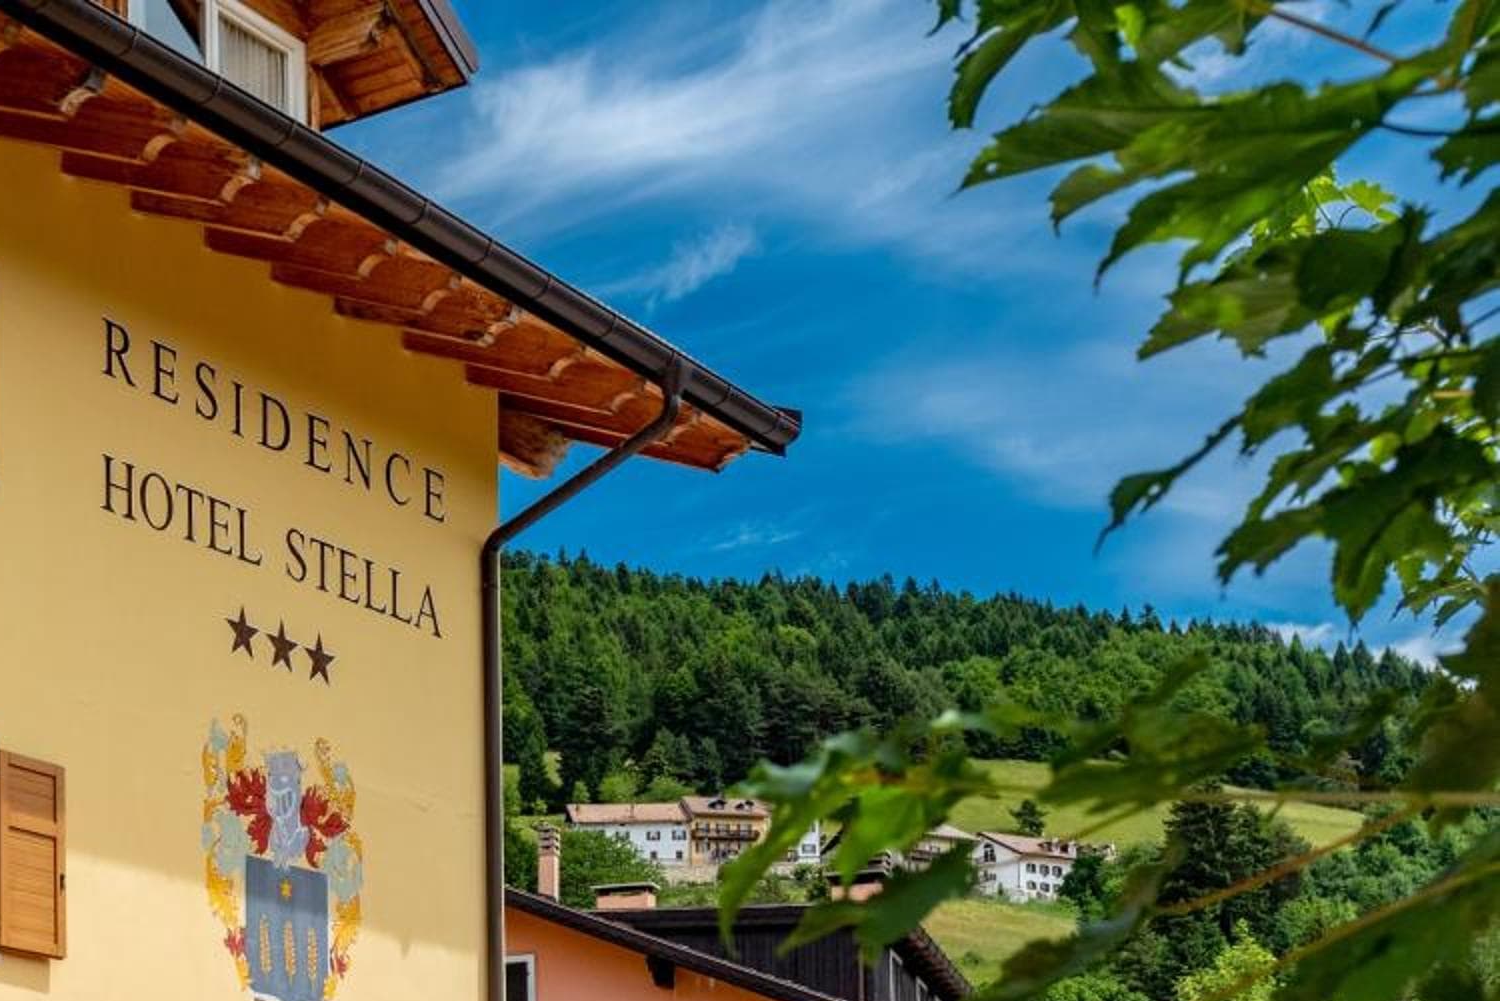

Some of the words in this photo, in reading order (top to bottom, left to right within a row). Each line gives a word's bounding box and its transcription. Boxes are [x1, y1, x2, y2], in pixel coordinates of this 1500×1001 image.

[102, 317, 446, 523] RESIDENCE
[101, 454, 262, 566] HOTEL
[285, 528, 442, 639] STELLA
